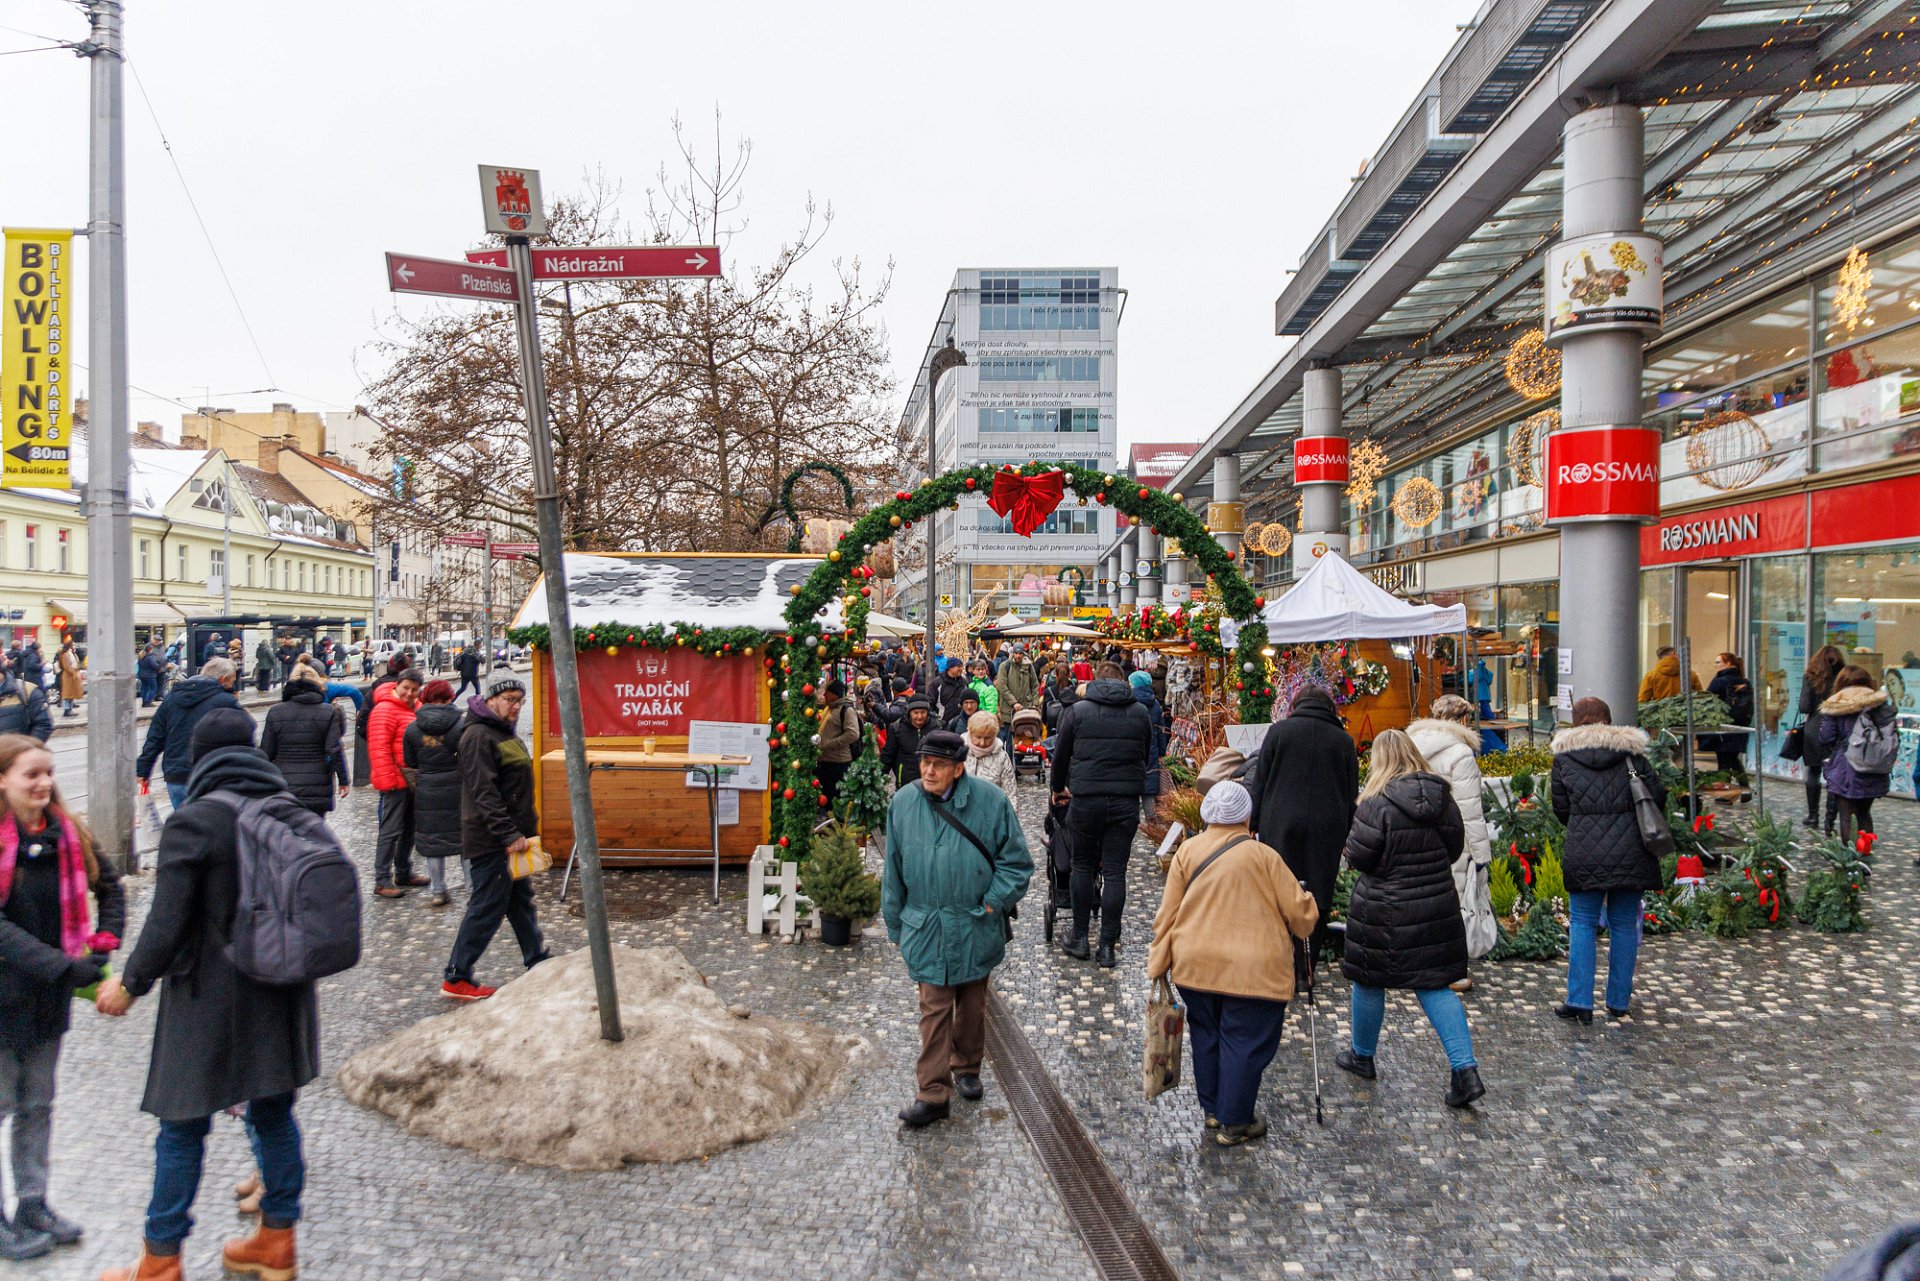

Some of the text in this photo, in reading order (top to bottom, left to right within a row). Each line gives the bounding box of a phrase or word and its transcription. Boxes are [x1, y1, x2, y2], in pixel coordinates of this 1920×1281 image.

[544, 255, 624, 273] Nádražní
[461, 273, 513, 295] Plzeňská
[1585, 311, 1616, 320] Vezmeme
[1616, 309, 1626, 317] Vás
[13, 242, 49, 439] BOWLING
[47, 242, 61, 440] BILLIARD & DARTS
[31, 446, 66, 460] 80m
[5, 466, 18, 474] Na
[57, 467, 69, 475] 25
[1660, 511, 1761, 552] ROSSMANN
[614, 680, 691, 698] TRADIČNÍ
[622, 699, 684, 717] SVAŘÁK
